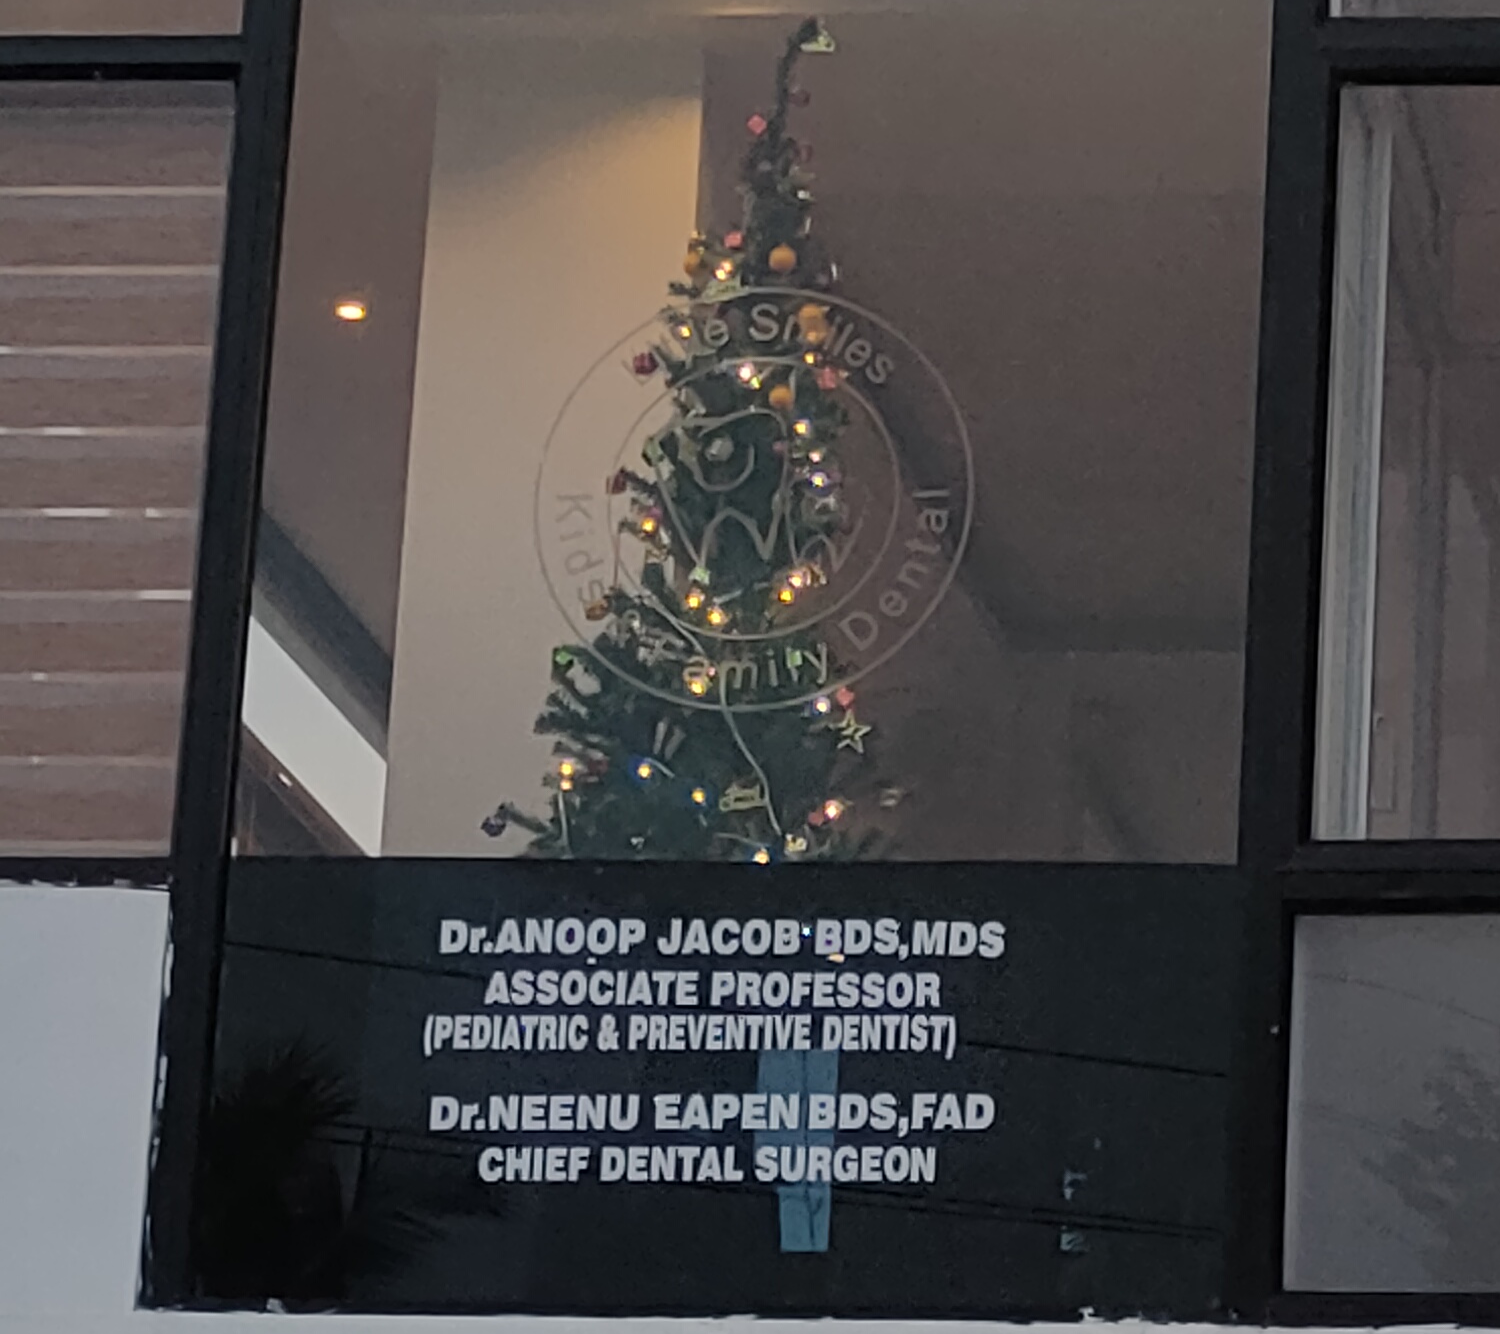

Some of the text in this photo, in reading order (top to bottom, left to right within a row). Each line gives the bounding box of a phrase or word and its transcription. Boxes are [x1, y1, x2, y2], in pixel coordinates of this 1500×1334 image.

[837, 488, 951, 652] Dental
[657, 918, 801, 955] JACOB
[815, 917, 1006, 962] BDS,MDS
[484, 969, 941, 1008] ASSOCIATE PROFESSOR
[423, 1014, 957, 1060] (PEDIATRIC & PREVENTIVE DENTIST)
[429, 1092, 995, 1138] Dr.NEENU EAPEN BDS,FAD
[478, 1145, 937, 1184] CHIEF DENTAL SURGEON
